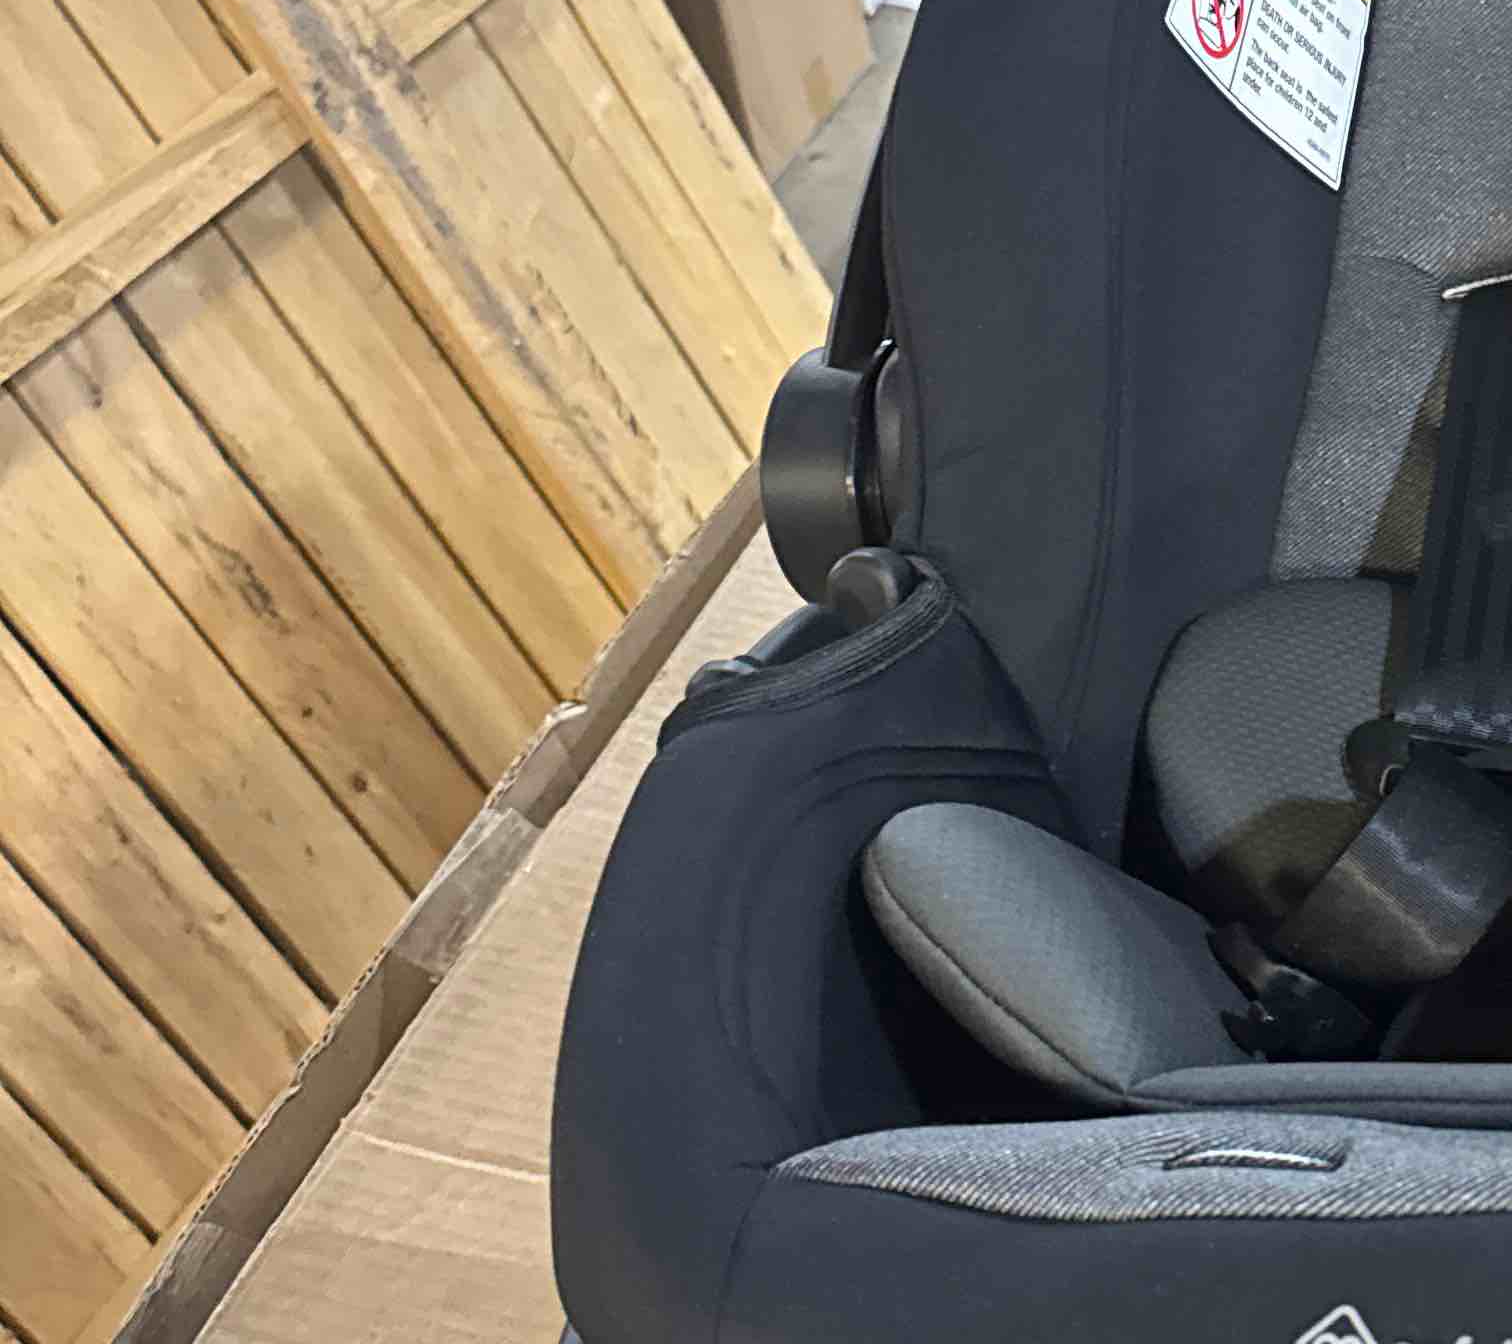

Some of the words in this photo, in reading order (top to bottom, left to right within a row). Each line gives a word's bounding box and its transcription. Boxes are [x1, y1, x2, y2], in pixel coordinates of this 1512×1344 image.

[1257, 16, 1270, 34] can
[1261, 0, 1284, 27] DEATH
[1283, 21, 1294, 38] OR
[1294, 30, 1323, 66] SERIOUS
[1323, 57, 1347, 88] INJURY
[1252, 37, 1264, 56] The
[1263, 51, 1279, 72] back
[1246, 56, 1265, 78] place
[1265, 71, 1275, 87] for
[1274, 84, 1304, 113] children
[1304, 106, 1315, 122] 12
[1313, 116, 1328, 133] and
